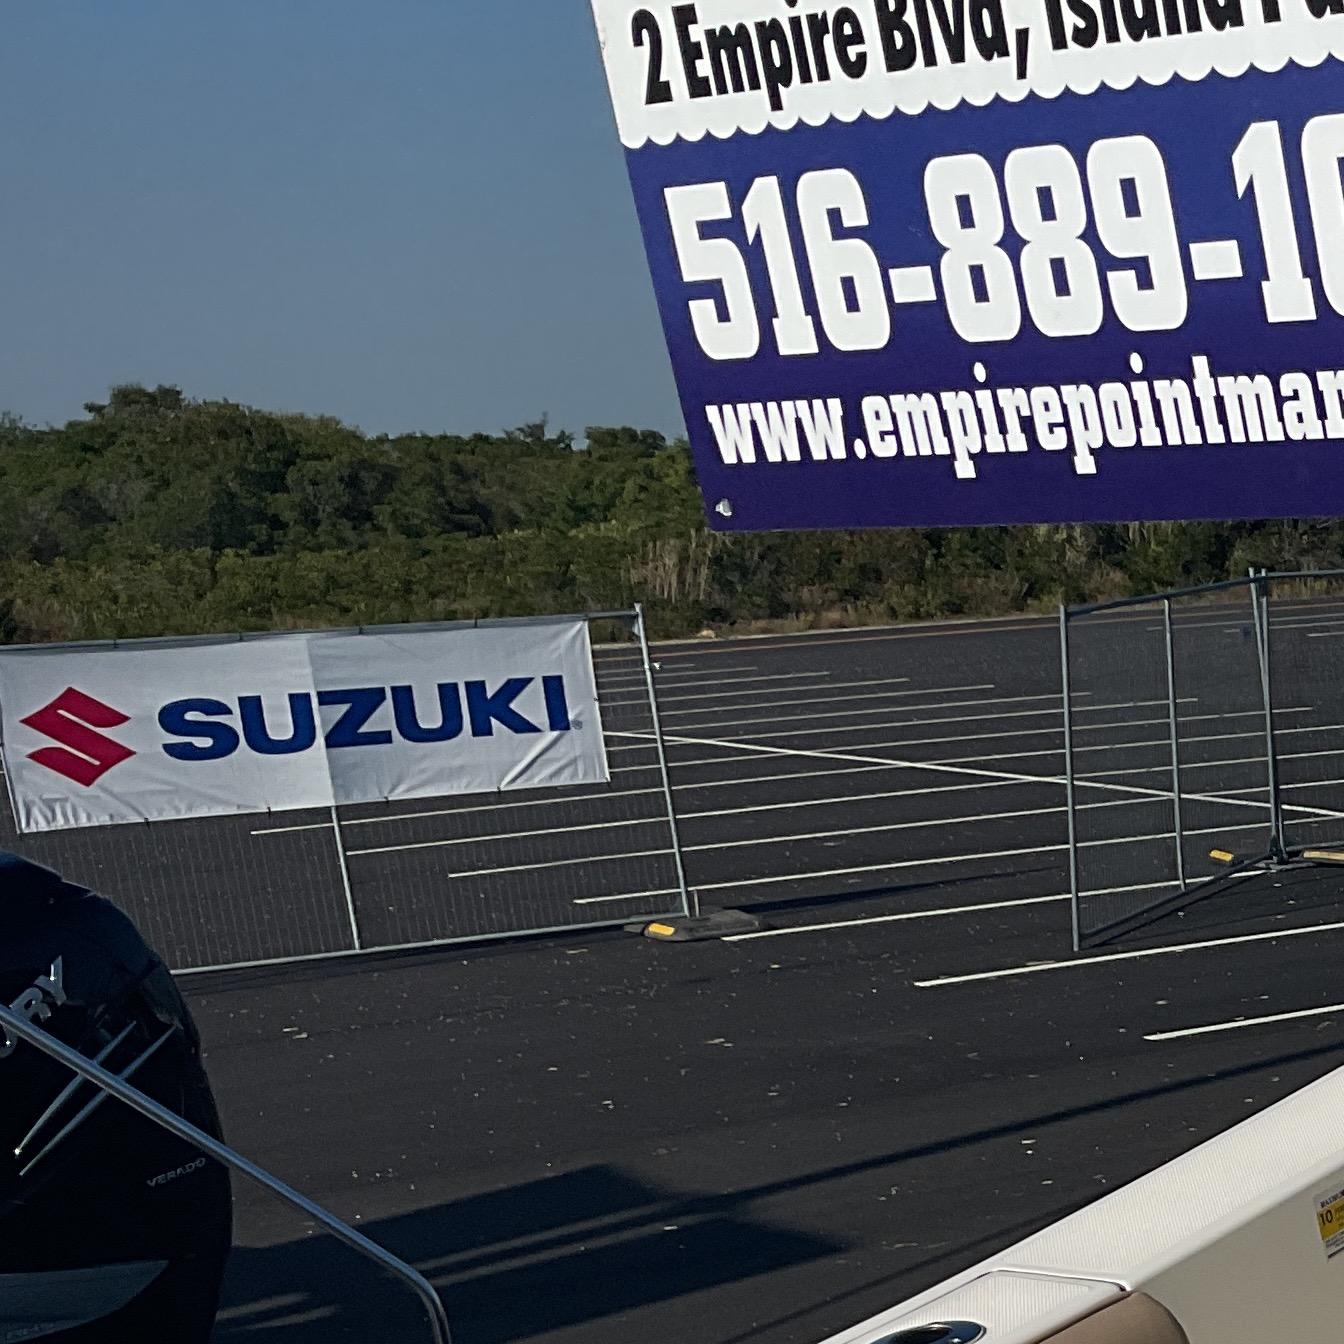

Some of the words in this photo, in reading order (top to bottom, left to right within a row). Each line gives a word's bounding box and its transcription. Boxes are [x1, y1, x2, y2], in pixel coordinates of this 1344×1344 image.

[631, 8, 673, 105] 2
[671, 0, 867, 111] Empire
[1045, 0, 1244, 50] Isa
[157, 675, 571, 761] SUZUKI
[146, 1157, 206, 1187] VERADO
[1320, 1209, 1334, 1226] 10
